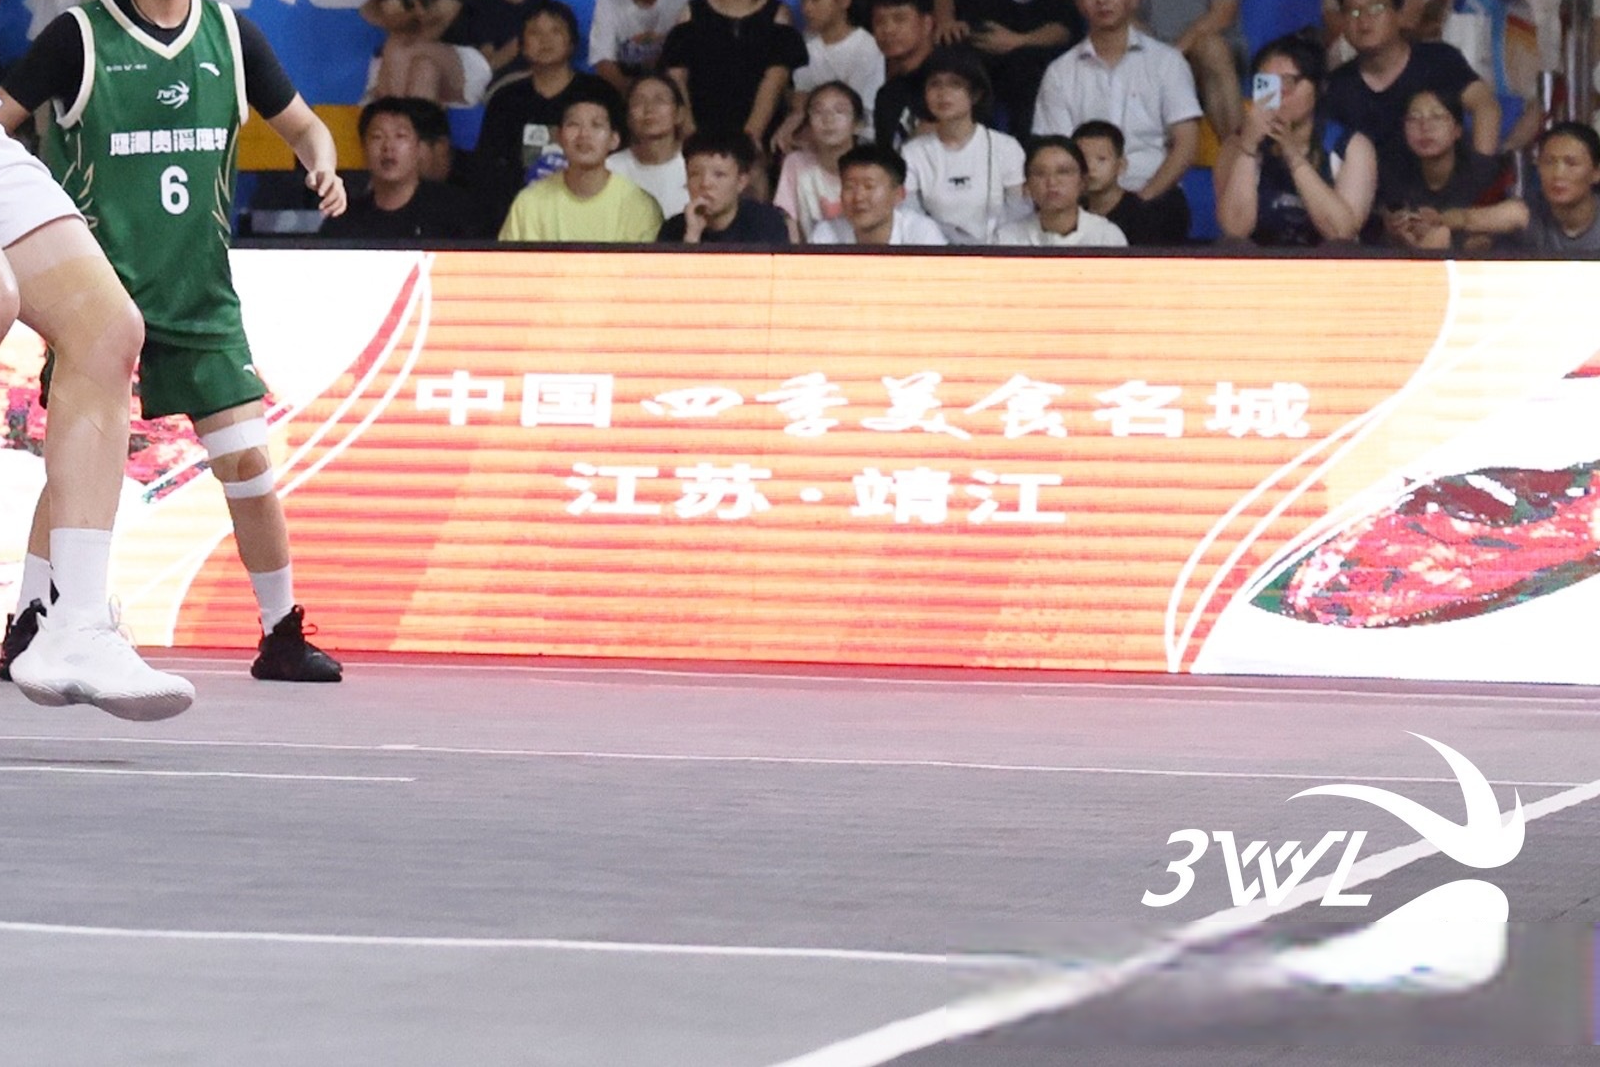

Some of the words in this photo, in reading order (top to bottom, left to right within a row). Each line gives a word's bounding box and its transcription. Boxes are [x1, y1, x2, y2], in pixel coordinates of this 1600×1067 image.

[160, 165, 190, 215] 6
[565, 461, 1067, 525] 江苏·靖江
